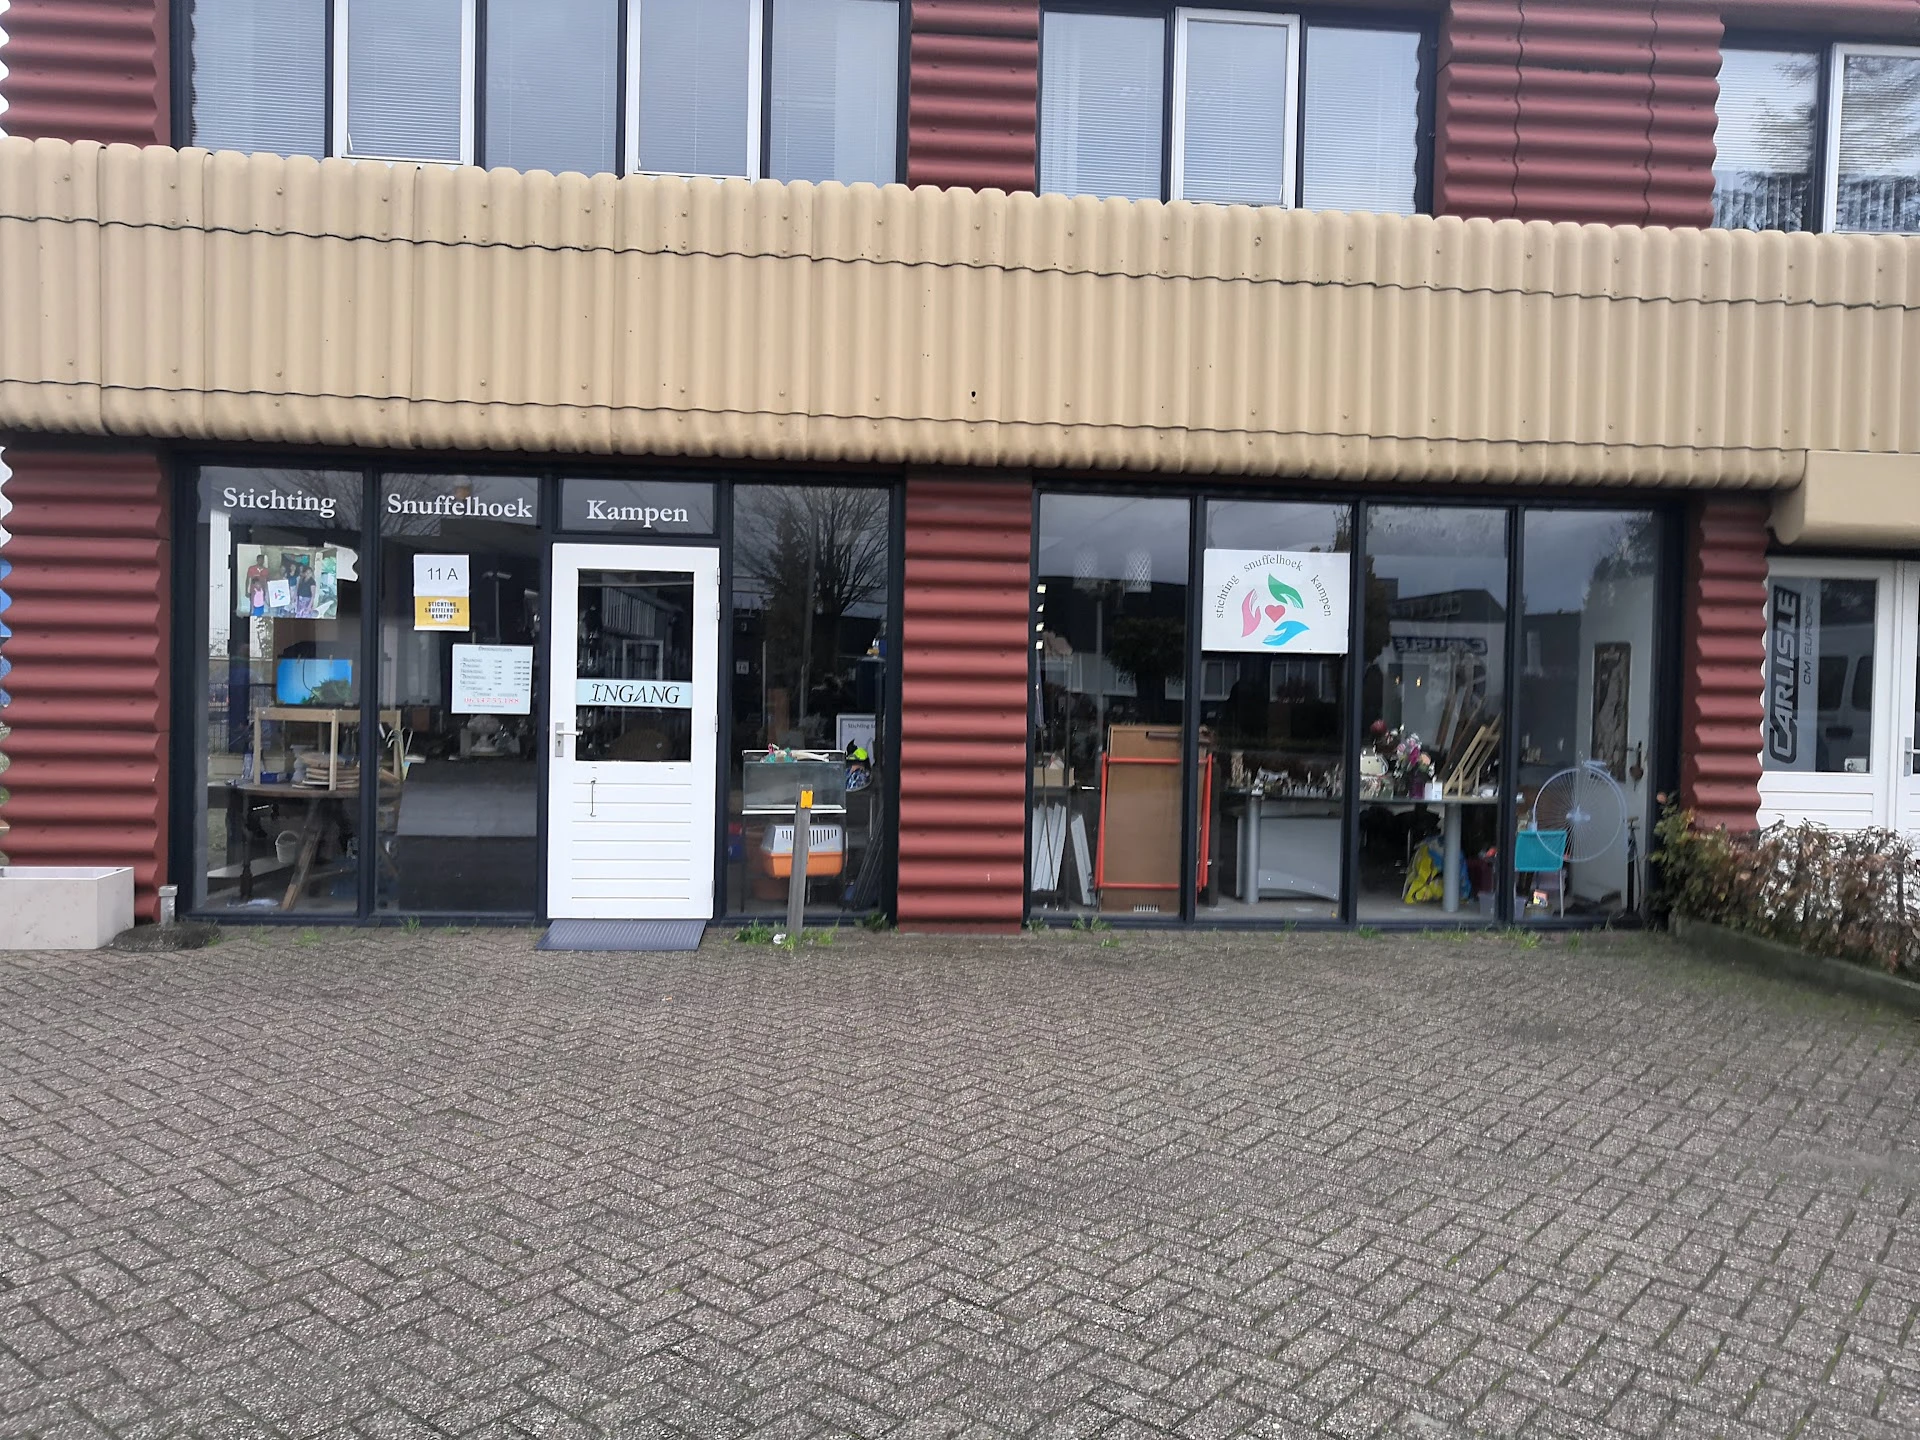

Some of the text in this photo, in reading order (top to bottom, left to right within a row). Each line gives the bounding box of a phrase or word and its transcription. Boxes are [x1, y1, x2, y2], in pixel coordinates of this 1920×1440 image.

[223, 487, 689, 528] Stichting Snuffelhoek Kampen
[427, 567, 459, 581] 11 A
[1214, 554, 1332, 619] stichting snuffelhoek kampen
[1803, 595, 1814, 685] CM EUROPE
[588, 683, 680, 704] INGANG
[1770, 585, 1801, 764] CARLISLE
